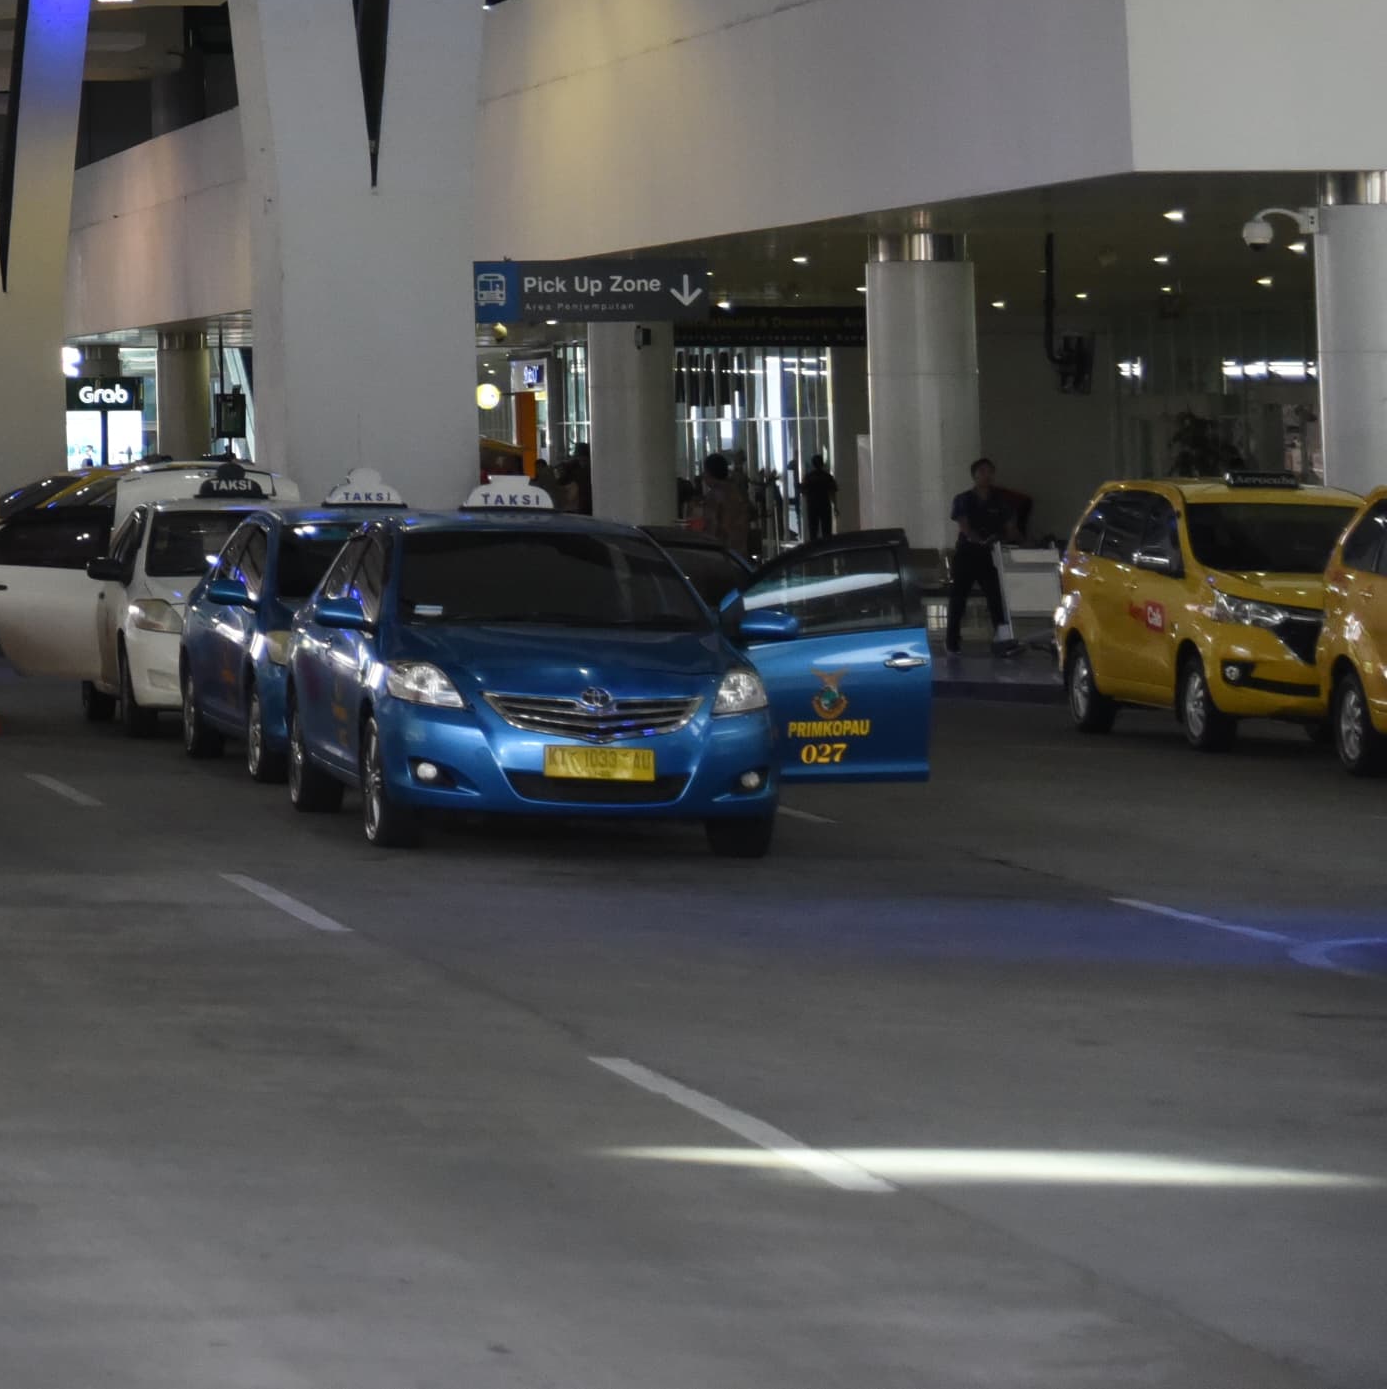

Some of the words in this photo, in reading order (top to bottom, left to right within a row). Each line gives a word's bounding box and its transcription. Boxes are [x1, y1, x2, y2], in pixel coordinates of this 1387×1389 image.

[523, 276, 567, 293] Pick
[574, 276, 602, 296] Up
[609, 275, 661, 293] Zone
[524, 303, 551, 311] Area
[78, 383, 129, 404] Grab
[210, 479, 252, 491] TAKSI
[343, 492, 391, 501] TAKSI
[481, 493, 540, 505] TAKSI
[1146, 605, 1163, 628] Cab
[787, 719, 871, 739] PRIMKOPAU
[548, 747, 566, 765] KT
[800, 742, 848, 764] 027
